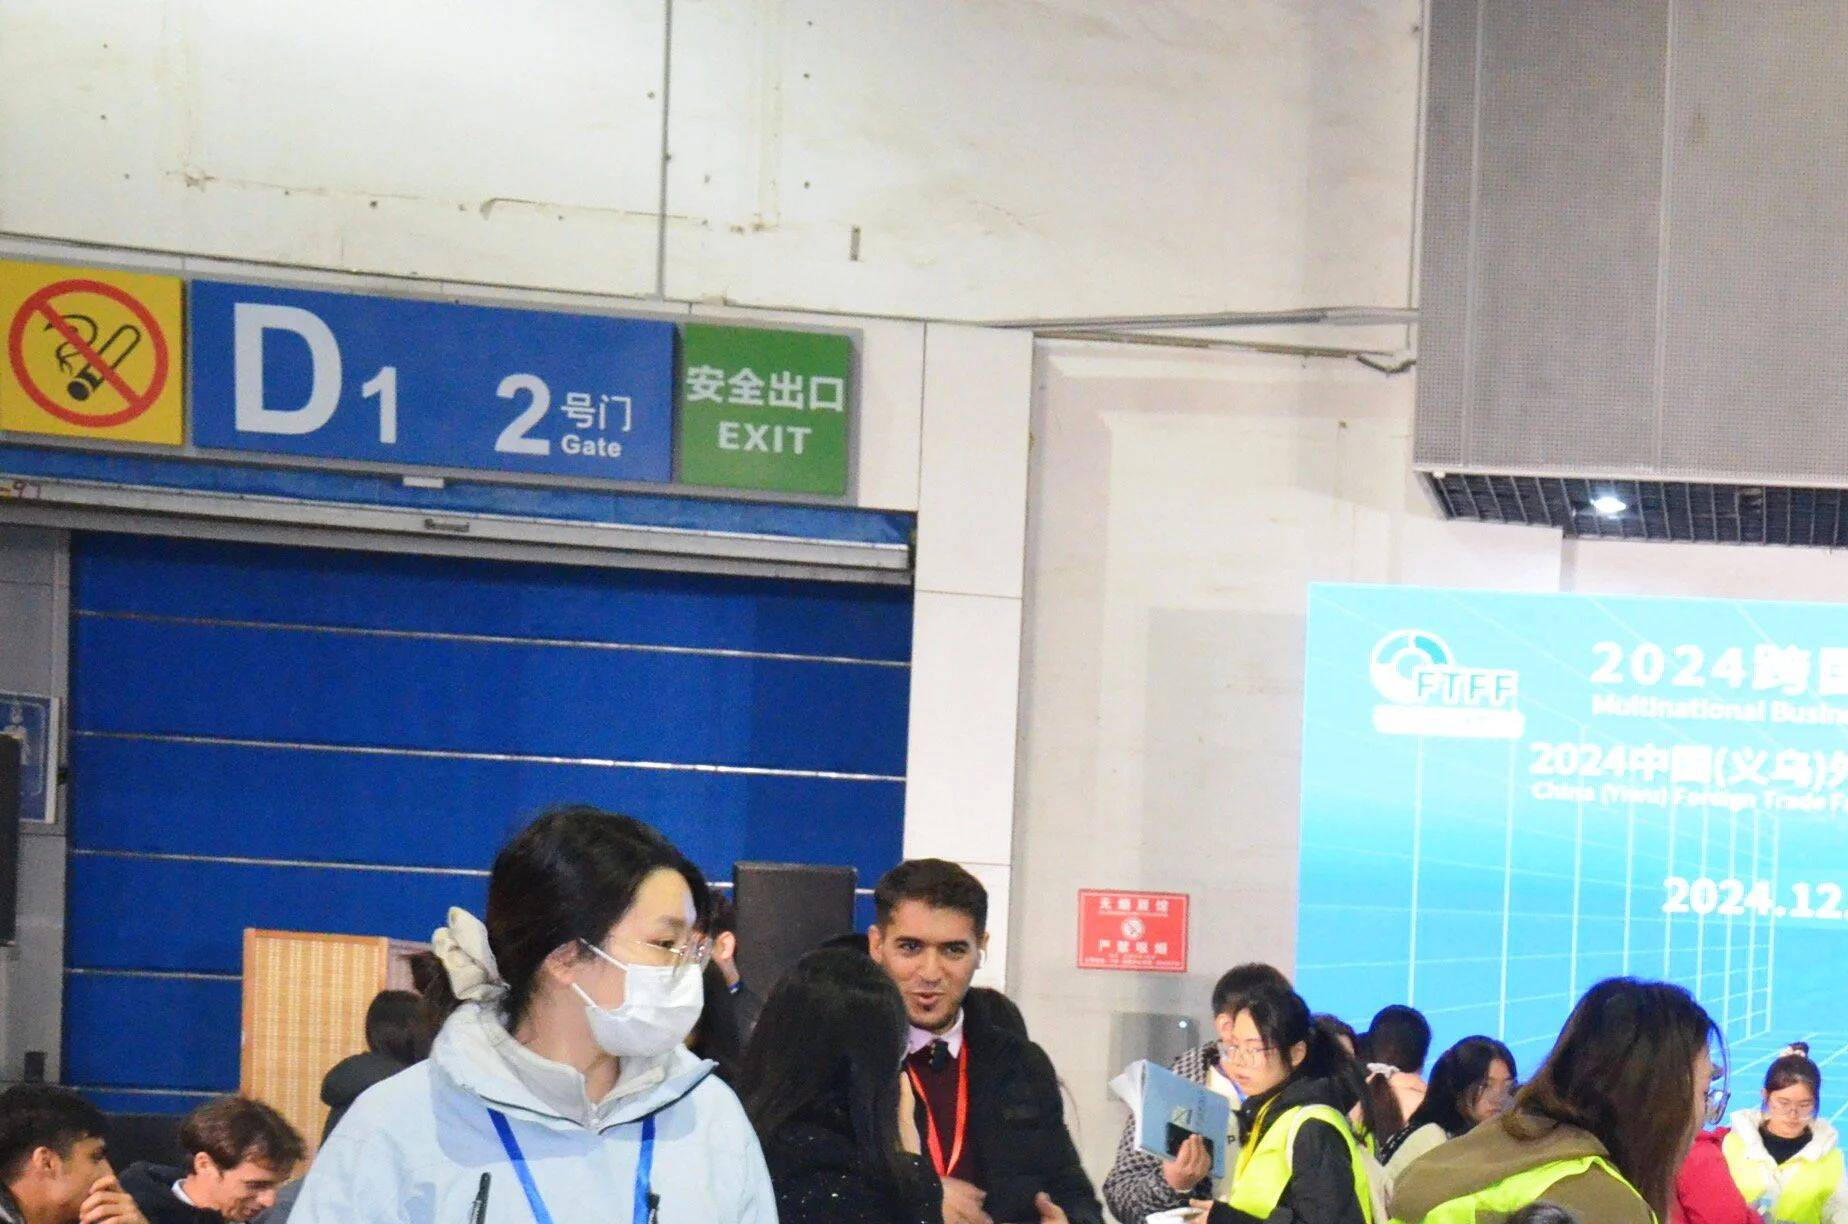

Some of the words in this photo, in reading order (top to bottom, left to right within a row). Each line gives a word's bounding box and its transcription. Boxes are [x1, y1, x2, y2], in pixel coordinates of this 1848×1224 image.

[686, 364, 844, 413] 安全出口
[560, 434, 621, 459] Gate
[719, 423, 812, 455] EXIT
[1592, 694, 1766, 722] Multinational
[1531, 782, 1594, 802] China
[1673, 787, 1756, 812] Foreign
[1763, 790, 1824, 811] Trade
